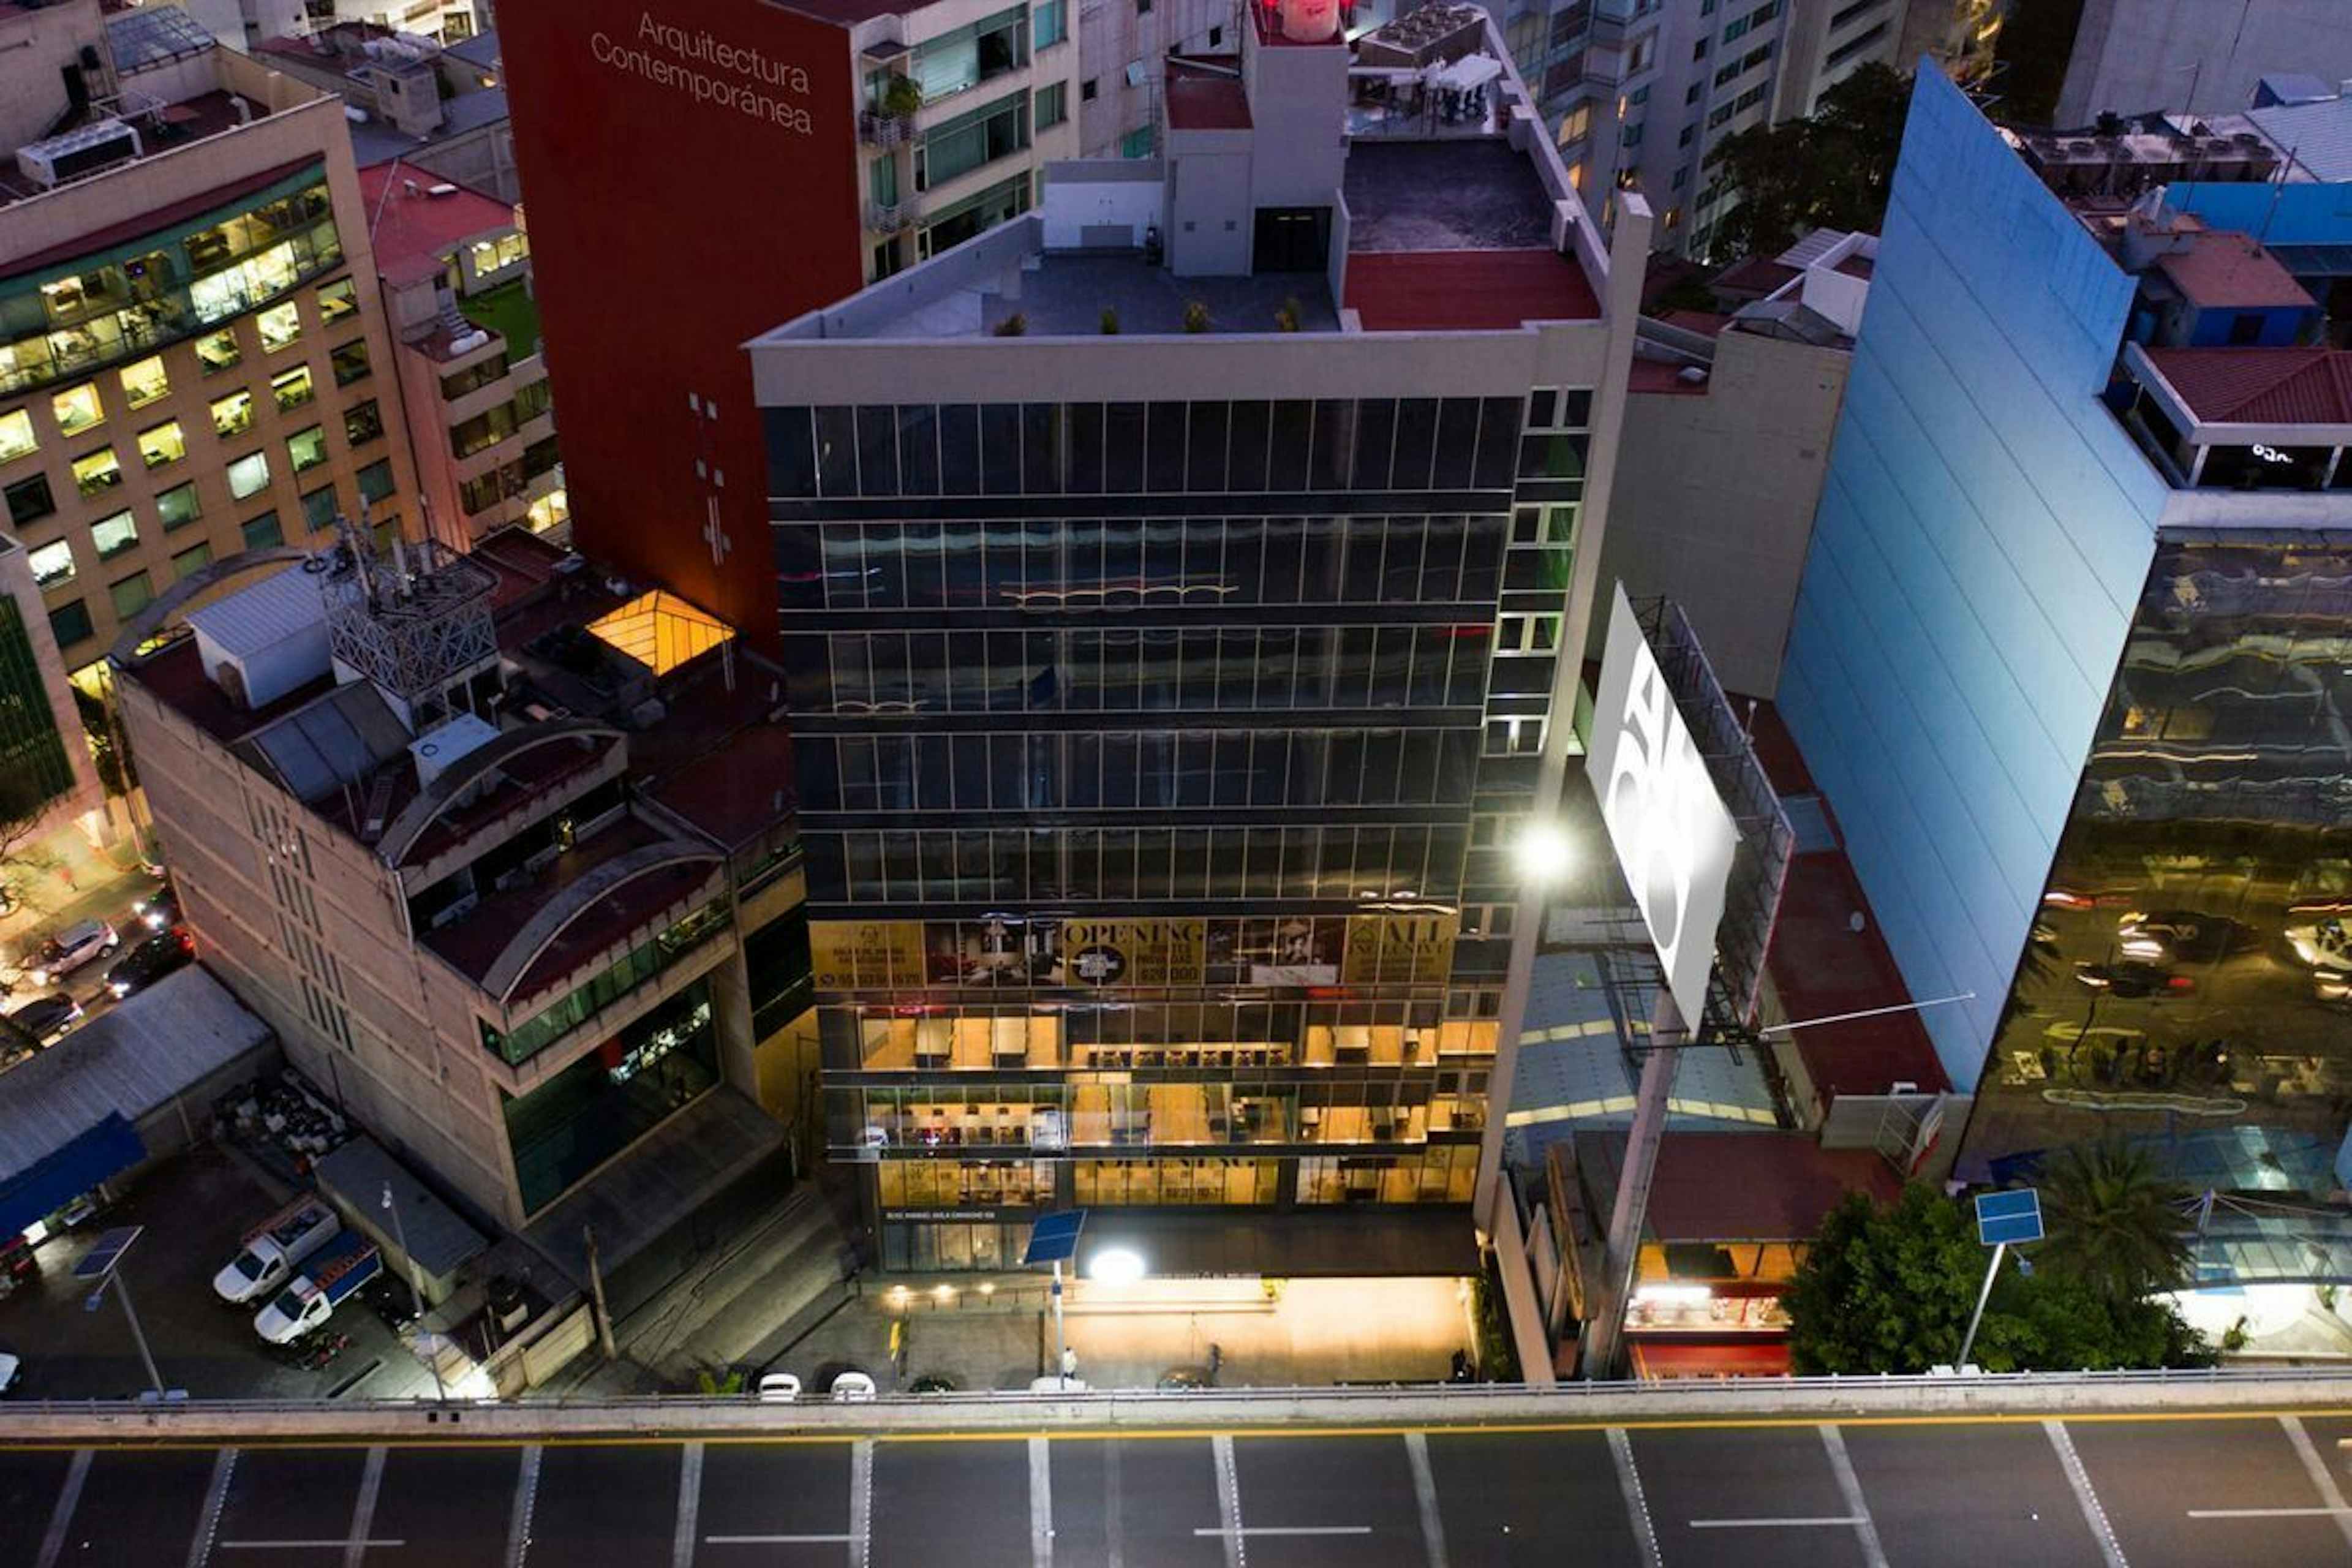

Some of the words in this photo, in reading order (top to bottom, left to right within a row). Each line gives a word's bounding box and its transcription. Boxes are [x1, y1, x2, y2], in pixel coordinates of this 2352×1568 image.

[638, 11, 810, 96] Arquitectura
[590, 31, 813, 136] Contemporánea
[1065, 924, 1204, 943] OPENING
[1384, 920, 1450, 942] ALL
